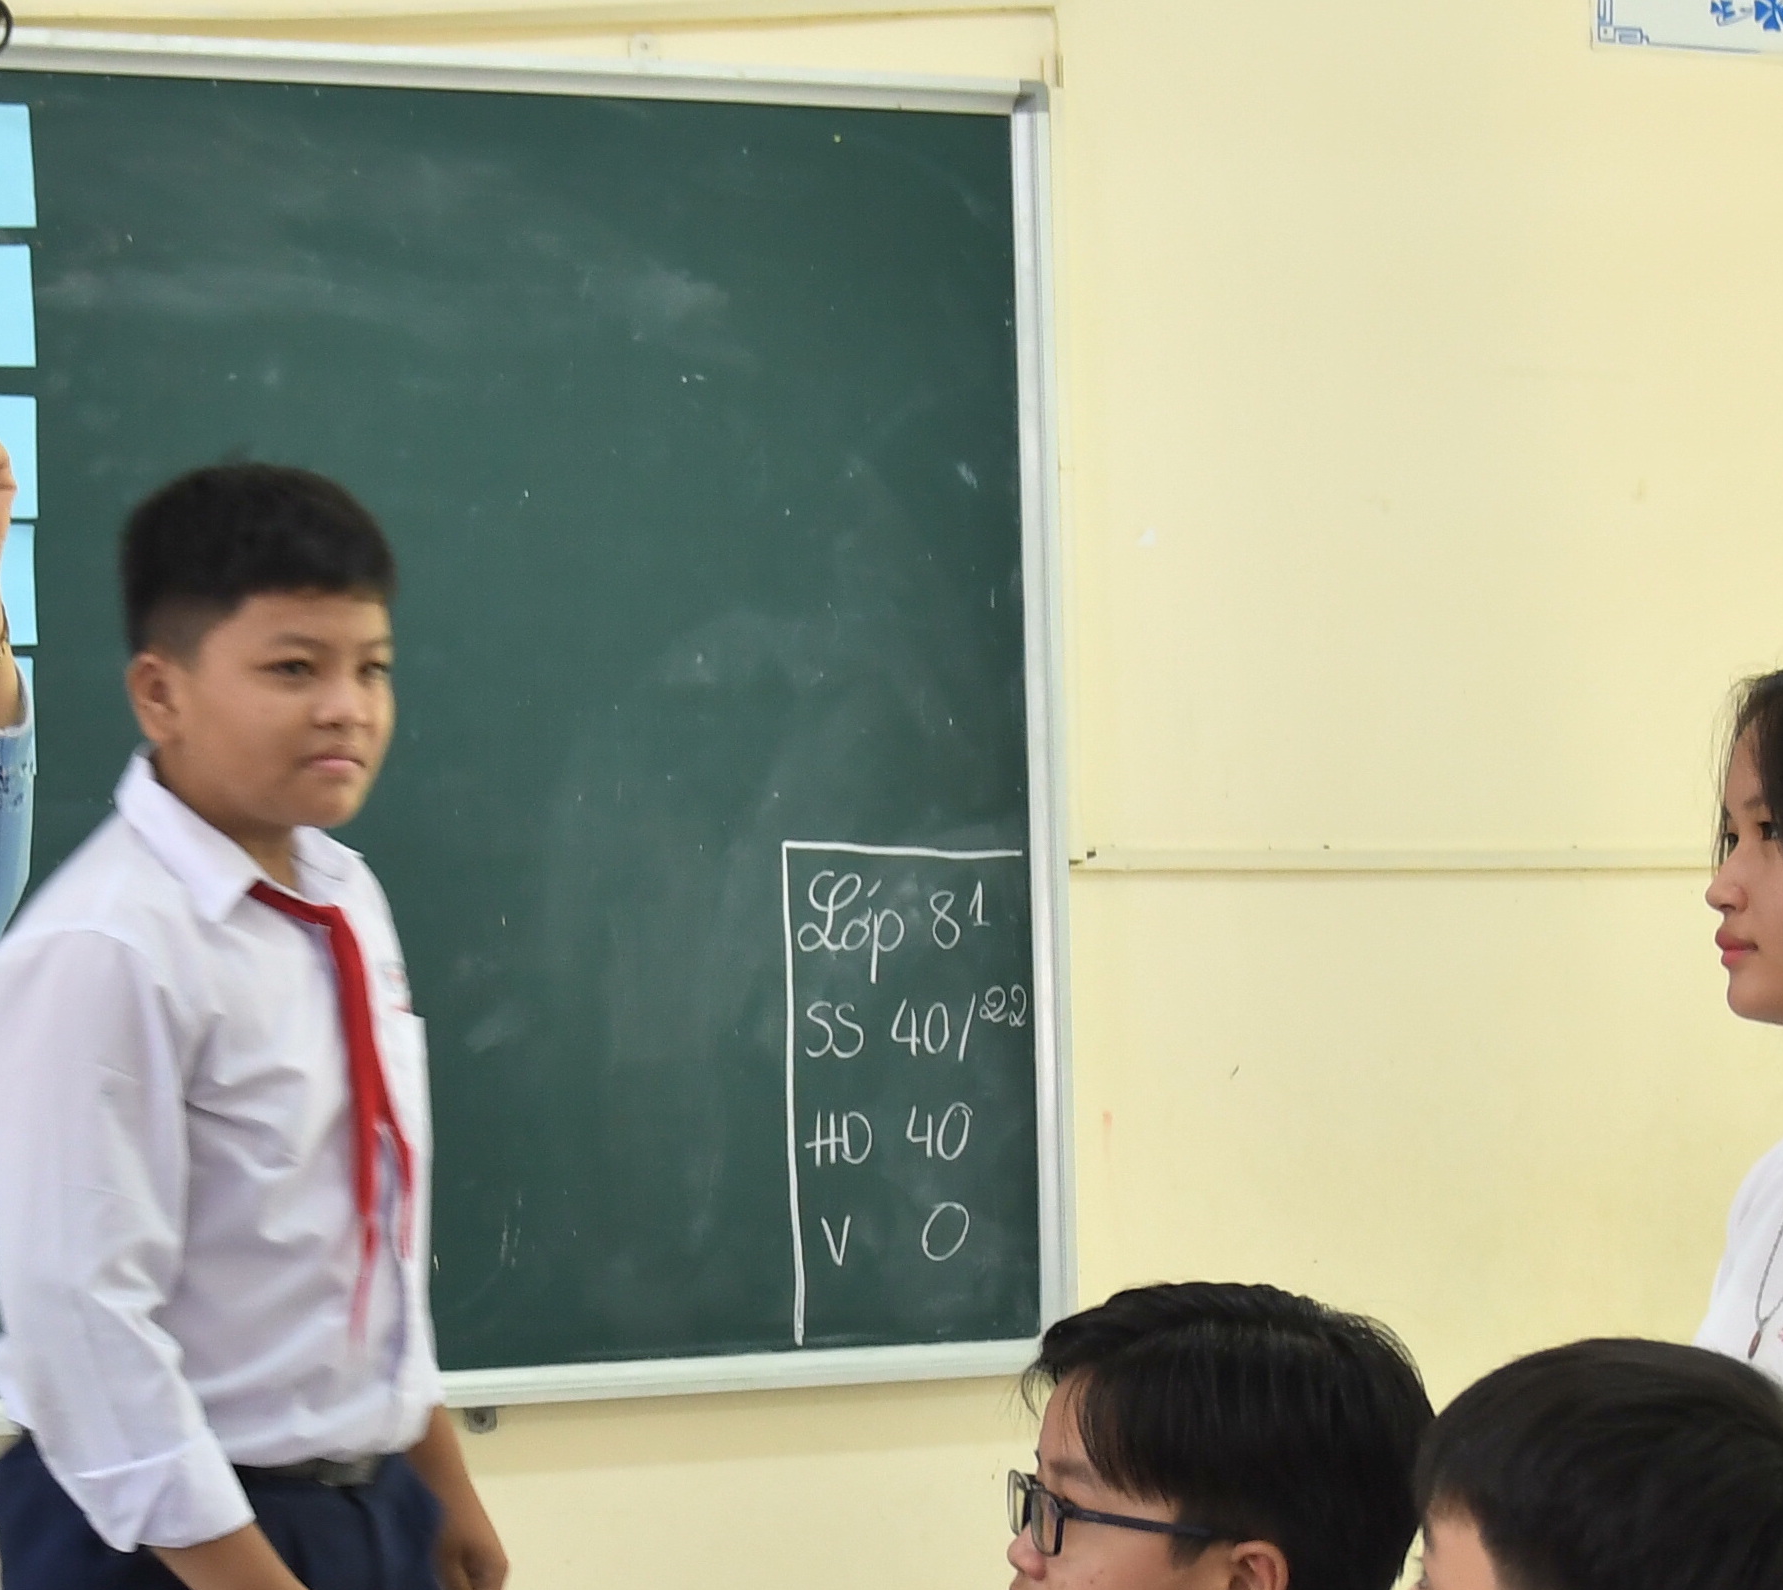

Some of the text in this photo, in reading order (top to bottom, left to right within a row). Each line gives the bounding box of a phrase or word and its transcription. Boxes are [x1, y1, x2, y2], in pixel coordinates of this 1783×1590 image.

[797, 870, 905, 984] Lớp
[805, 1000, 865, 1059] SS
[906, 1101, 974, 1161] 40
[921, 1201, 969, 1262] 0
